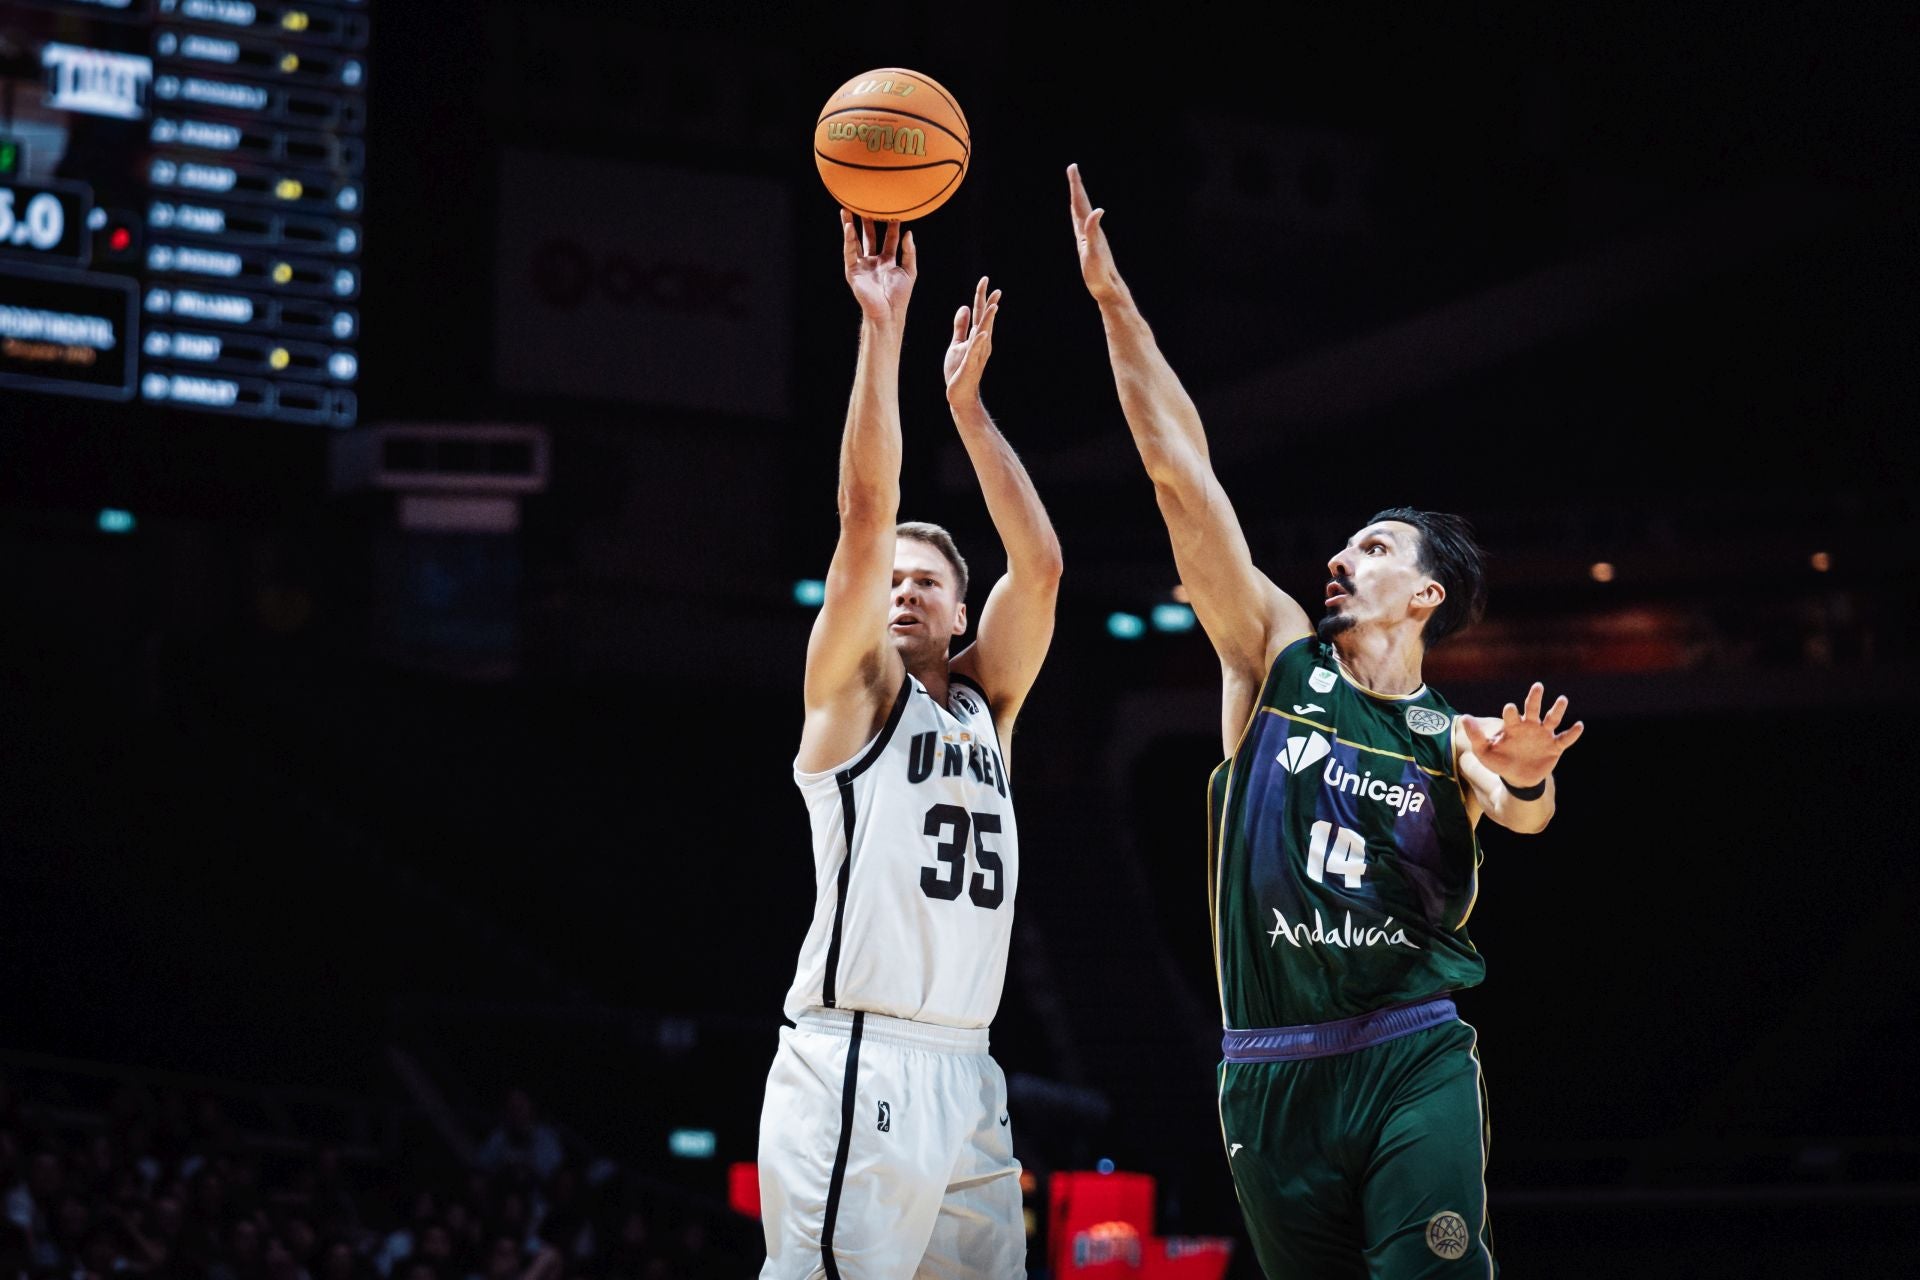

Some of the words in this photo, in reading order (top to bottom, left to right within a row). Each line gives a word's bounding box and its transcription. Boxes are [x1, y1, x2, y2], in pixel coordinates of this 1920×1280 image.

[828, 122, 927, 156] Wilson
[1323, 757, 1426, 817] Unicaja
[920, 803, 1004, 910] 35
[1306, 820, 1367, 888] 14
[1266, 907, 1421, 950] Andalucía
